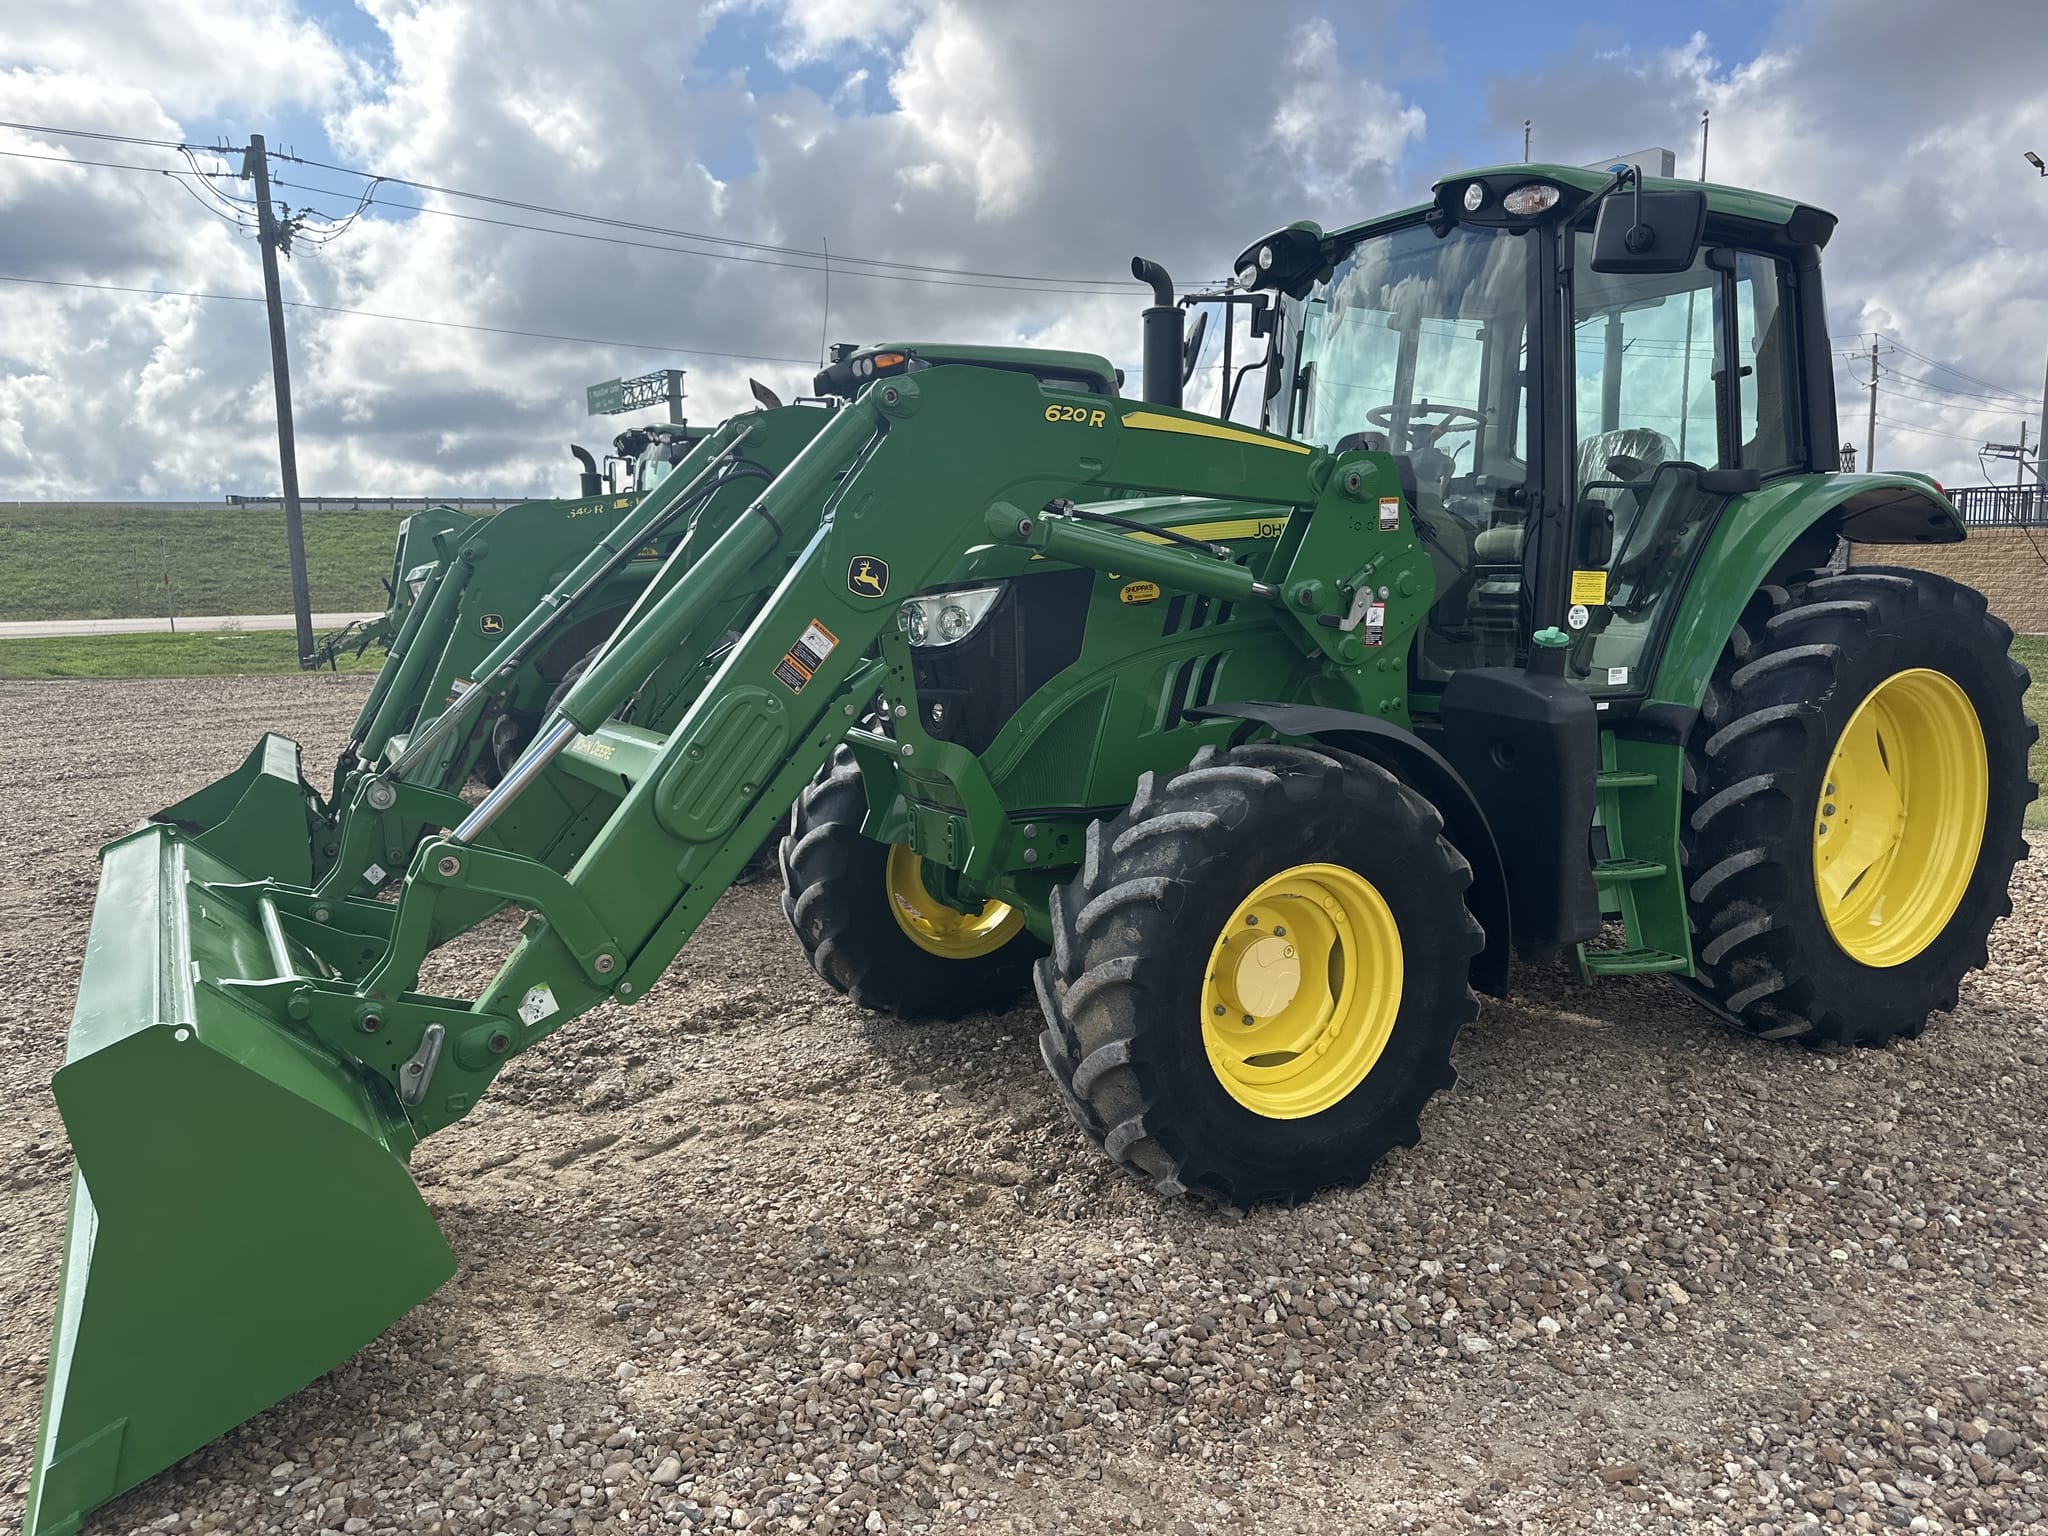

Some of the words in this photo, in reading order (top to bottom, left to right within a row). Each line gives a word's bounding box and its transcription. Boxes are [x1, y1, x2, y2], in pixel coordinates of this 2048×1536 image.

[1044, 404, 1088, 422] 620
[1088, 409, 1106, 428] R
[590, 739, 616, 760] DEERE
